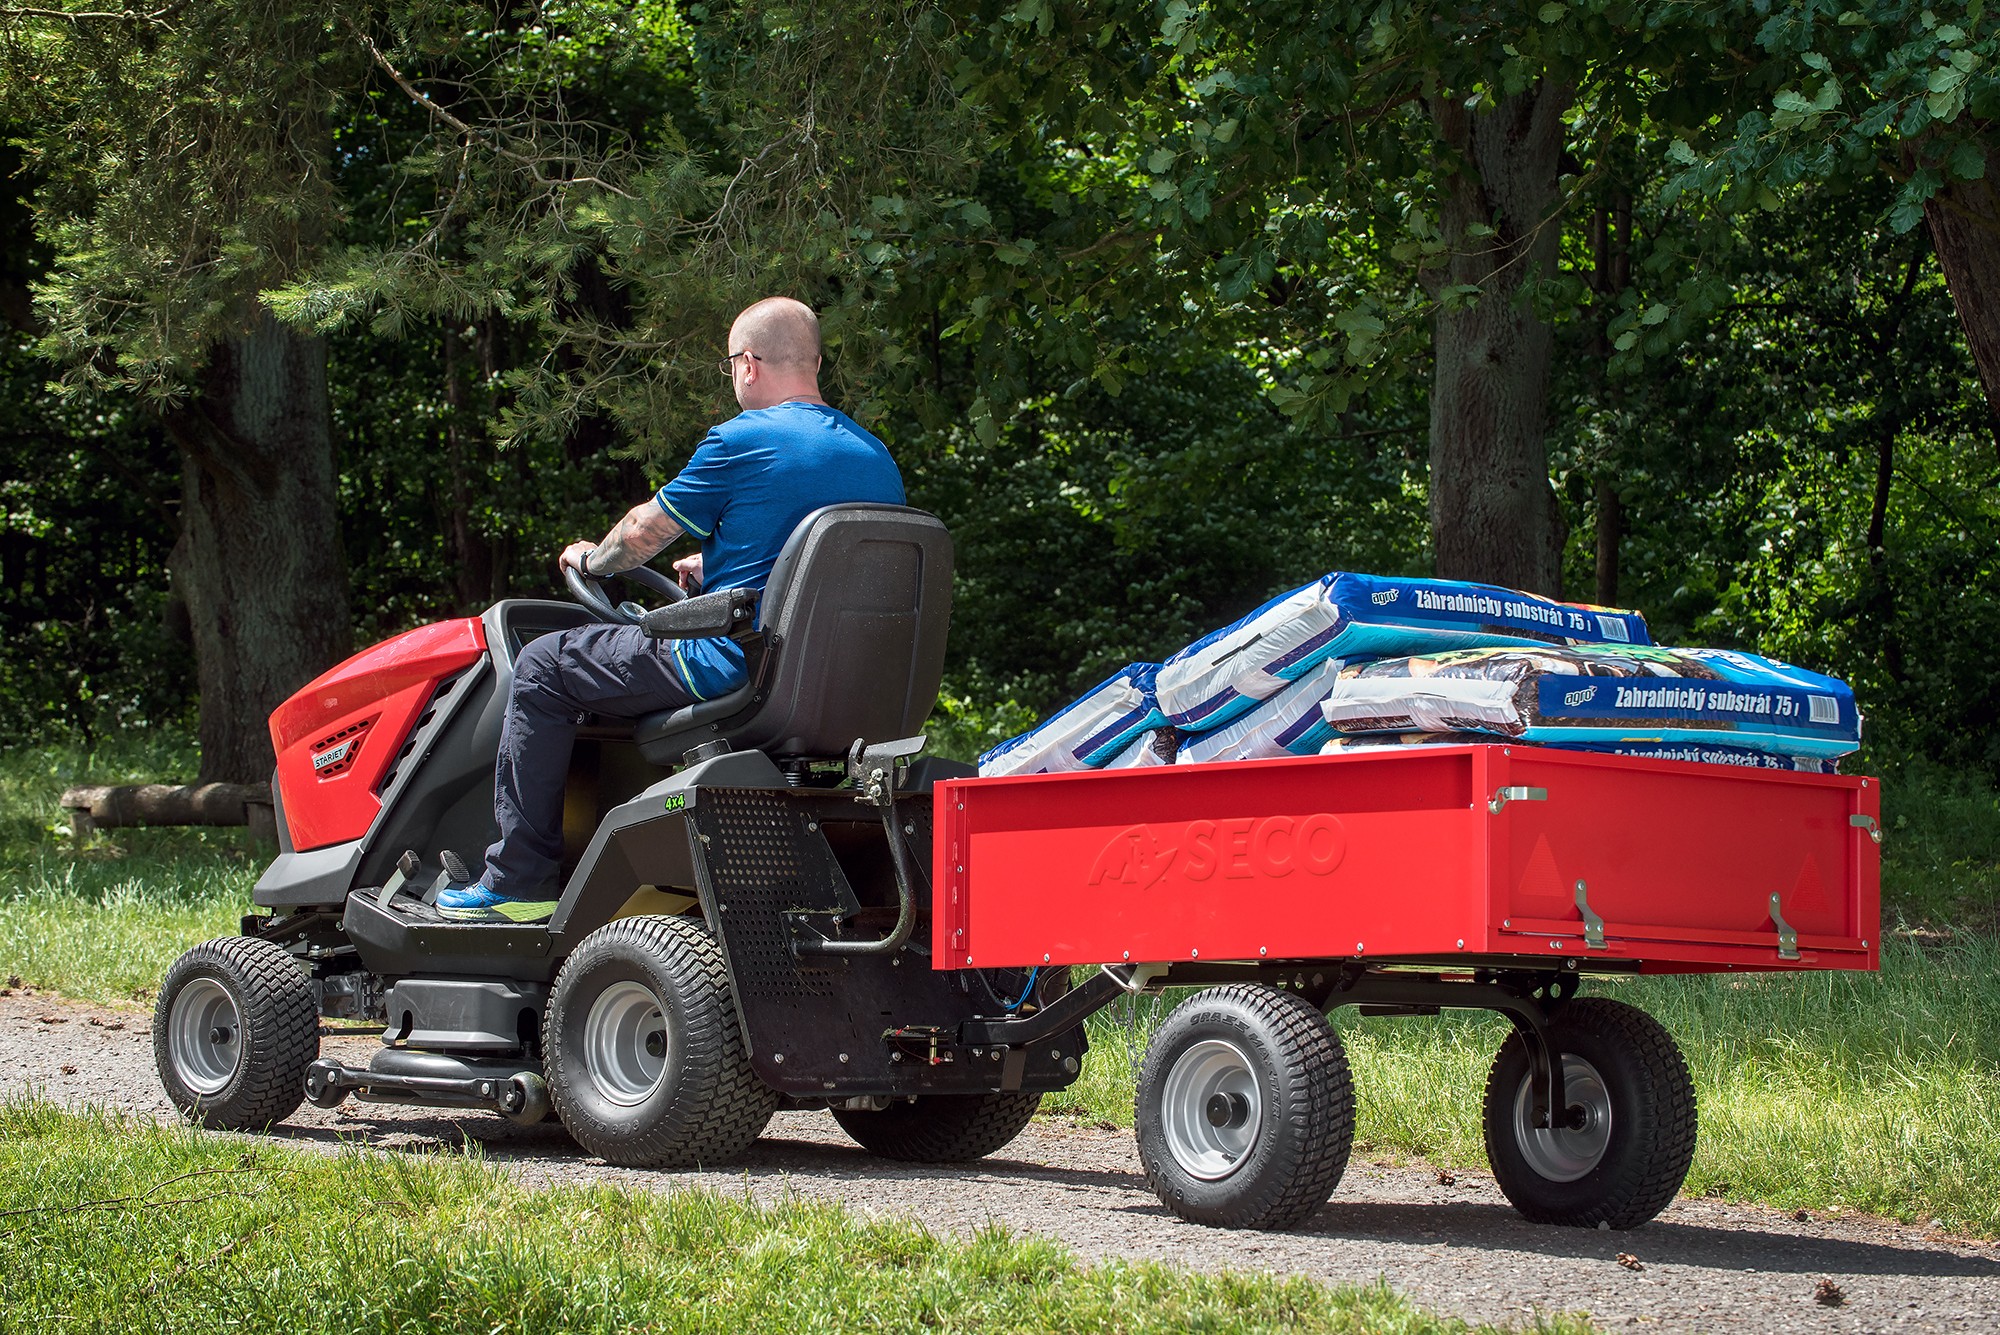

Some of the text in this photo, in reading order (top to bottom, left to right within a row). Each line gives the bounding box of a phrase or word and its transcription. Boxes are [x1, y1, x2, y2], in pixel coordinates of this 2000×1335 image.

[1371, 588, 1399, 606] agro
[1415, 589, 1502, 618] Záhradnícky
[1504, 600, 1564, 627] substrát
[1567, 612, 1585, 631] 75
[1564, 685, 1597, 707] agro
[1615, 686, 1706, 712] Zahradnický
[1707, 690, 1771, 714] substrát
[1775, 694, 1792, 716] 75
[315, 748, 343, 768] STARJET
[665, 792, 685, 811] 4x4
[1184, 813, 1347, 882] SECO
[1190, 1012, 1250, 1034] GRASS
